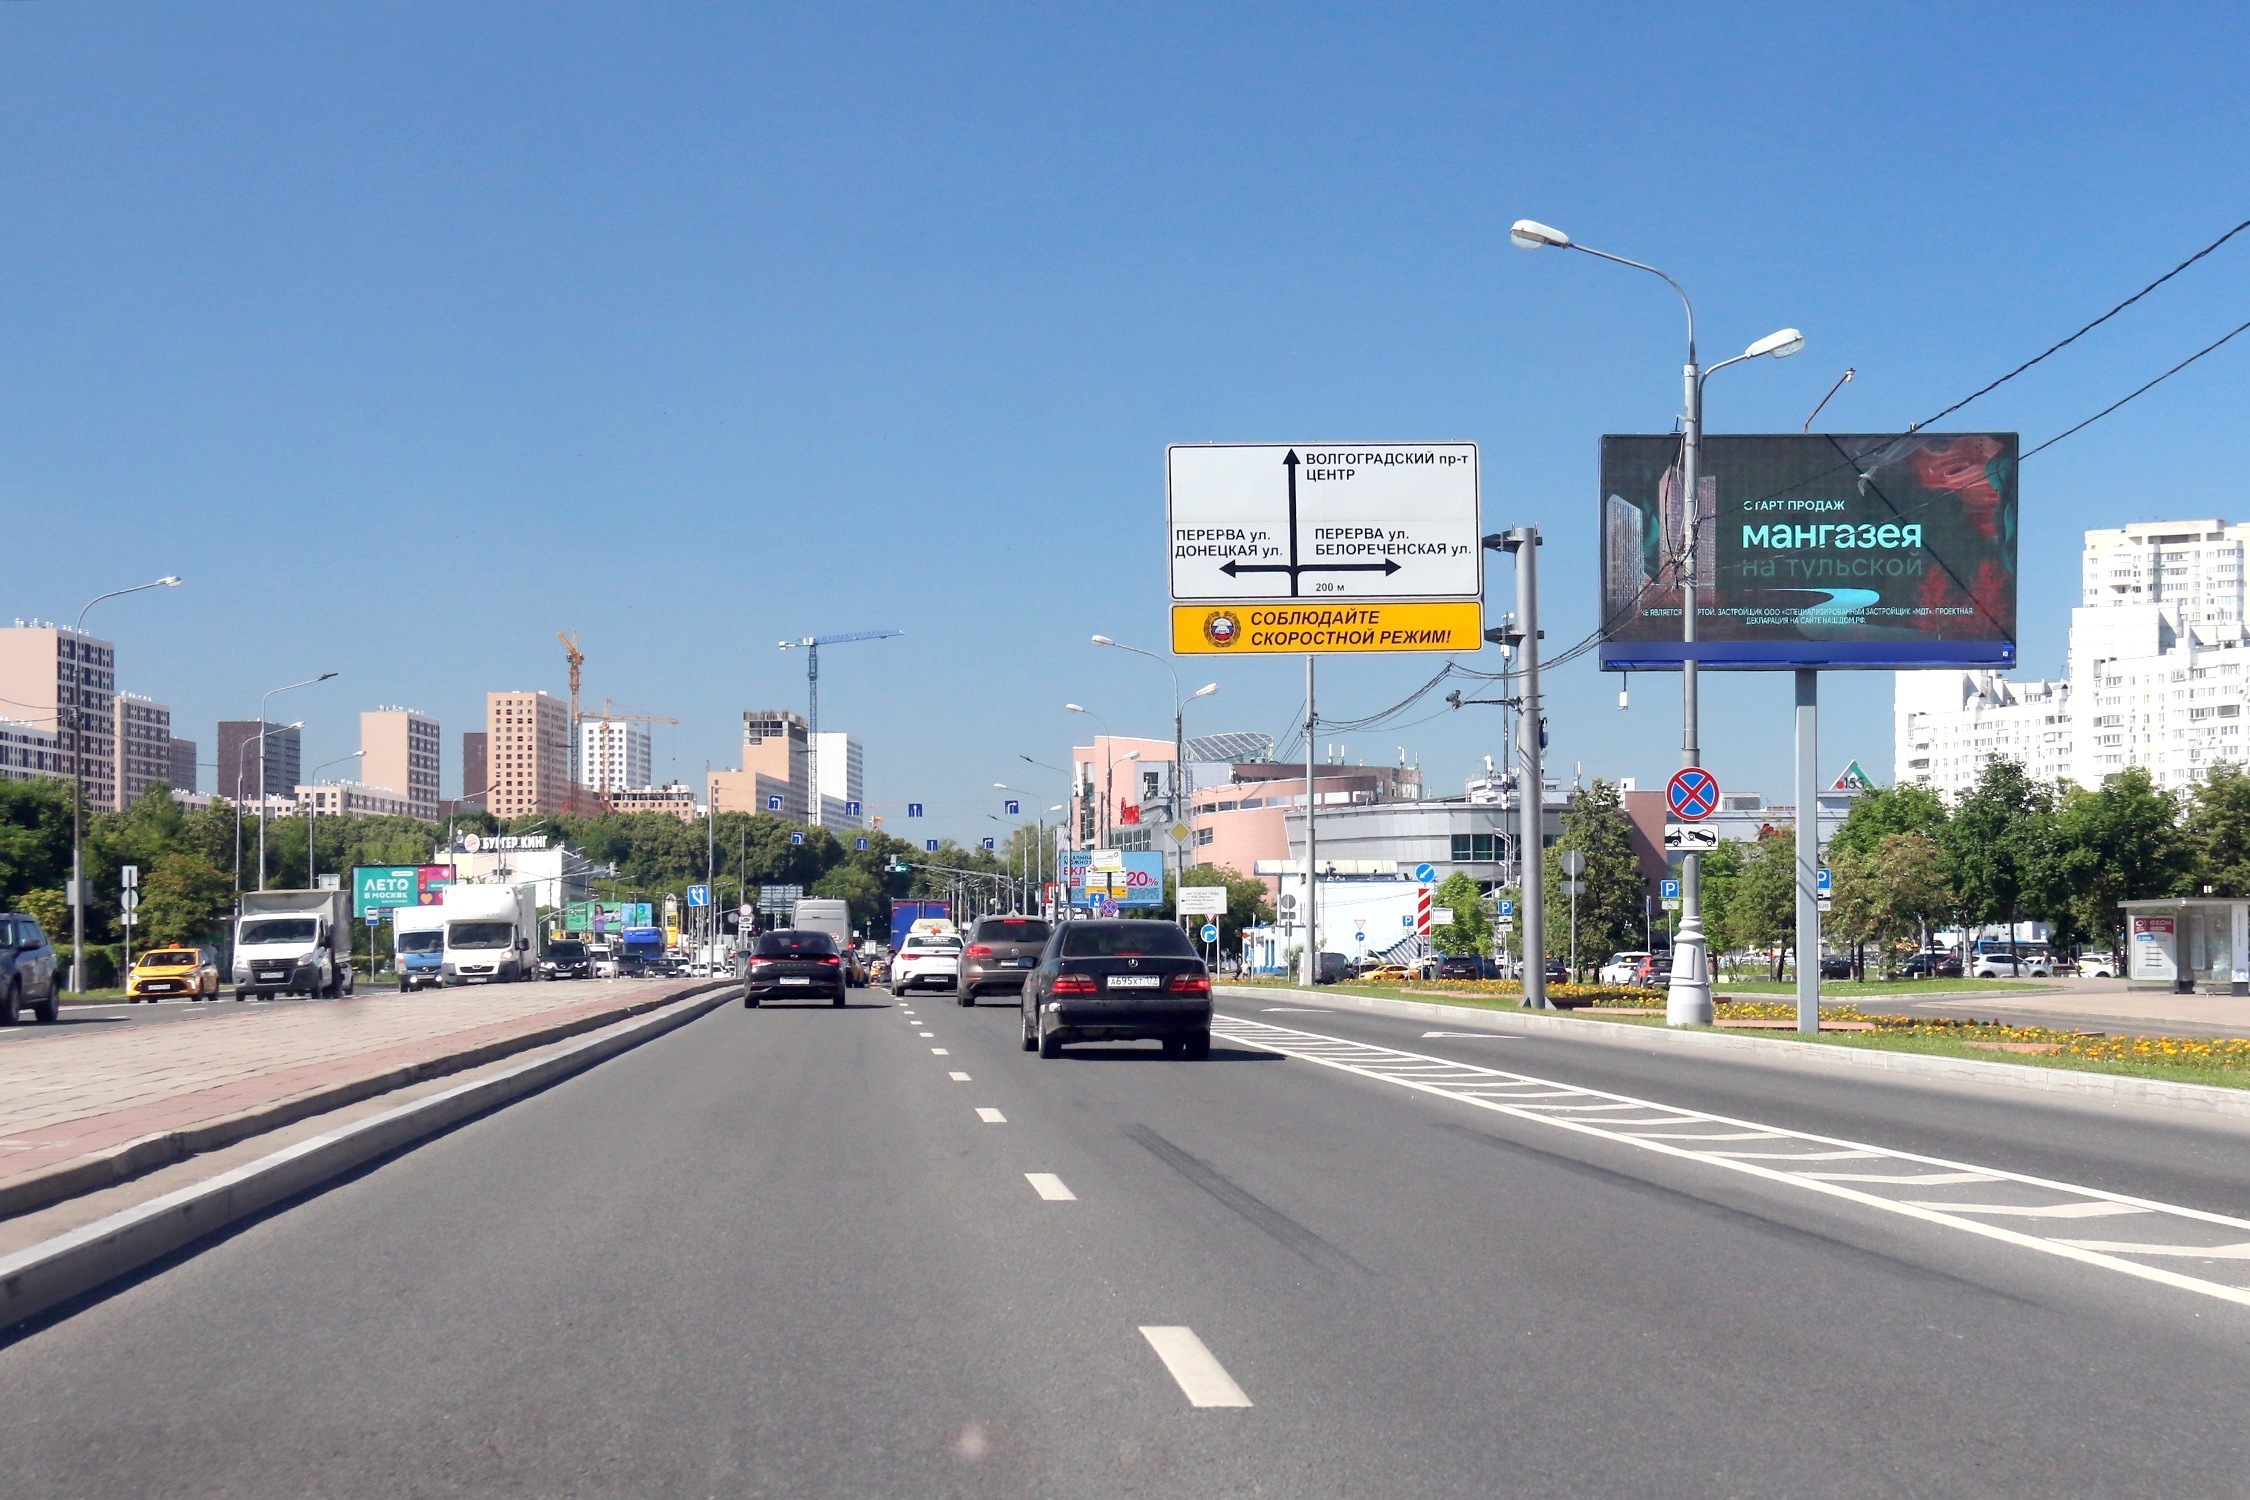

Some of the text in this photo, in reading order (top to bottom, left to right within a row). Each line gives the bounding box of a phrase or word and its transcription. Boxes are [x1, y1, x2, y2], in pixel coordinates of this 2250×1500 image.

[1306, 451, 1468, 466] ВОЛГОГРАДСКИЙ пр-т
[1306, 469, 1355, 482] ЦЕНТР
[1788, 500, 1845, 512] ПРОДАЖ
[1176, 529, 1271, 543] ПЕРЕРВА ул.
[1315, 528, 1409, 541] ПЕРЕРВА ул.
[1742, 523, 1922, 549] мангазея
[1175, 545, 1283, 559] ДОНЕЦКАЯ ул.
[1316, 543, 1472, 557] БЕЛОРЕЧЕНСКАЯ ул.
[1742, 551, 1922, 580] на тульской
[1315, 583, 1334, 592] 200
[1251, 608, 1380, 628] СОБЛЮДАЙТЕ
[1650, 608, 1682, 616] ЯВЛЯЕТСЯ
[1718, 607, 1762, 616] ЗАСТРОЙЩИК
[1764, 608, 1780, 616] ООО
[1866, 607, 1910, 616] ЗАСТРОЙЩИК
[1935, 607, 1973, 616] ПРОЕКТНАЯ
[1746, 617, 1789, 625] ДЕКЛАРАЦИЯ
[1790, 616, 1799, 625] НА
[1251, 628, 1452, 646] СКОРОСТНОЙ РЕЖИМ!
[520, 835, 548, 849] КИНГ
[1063, 866, 1087, 876] ВКЛ
[364, 878, 409, 892] ЛЕТО
[1126, 871, 1159, 887] 20%
[364, 891, 408, 899] В МОСКВЕ
